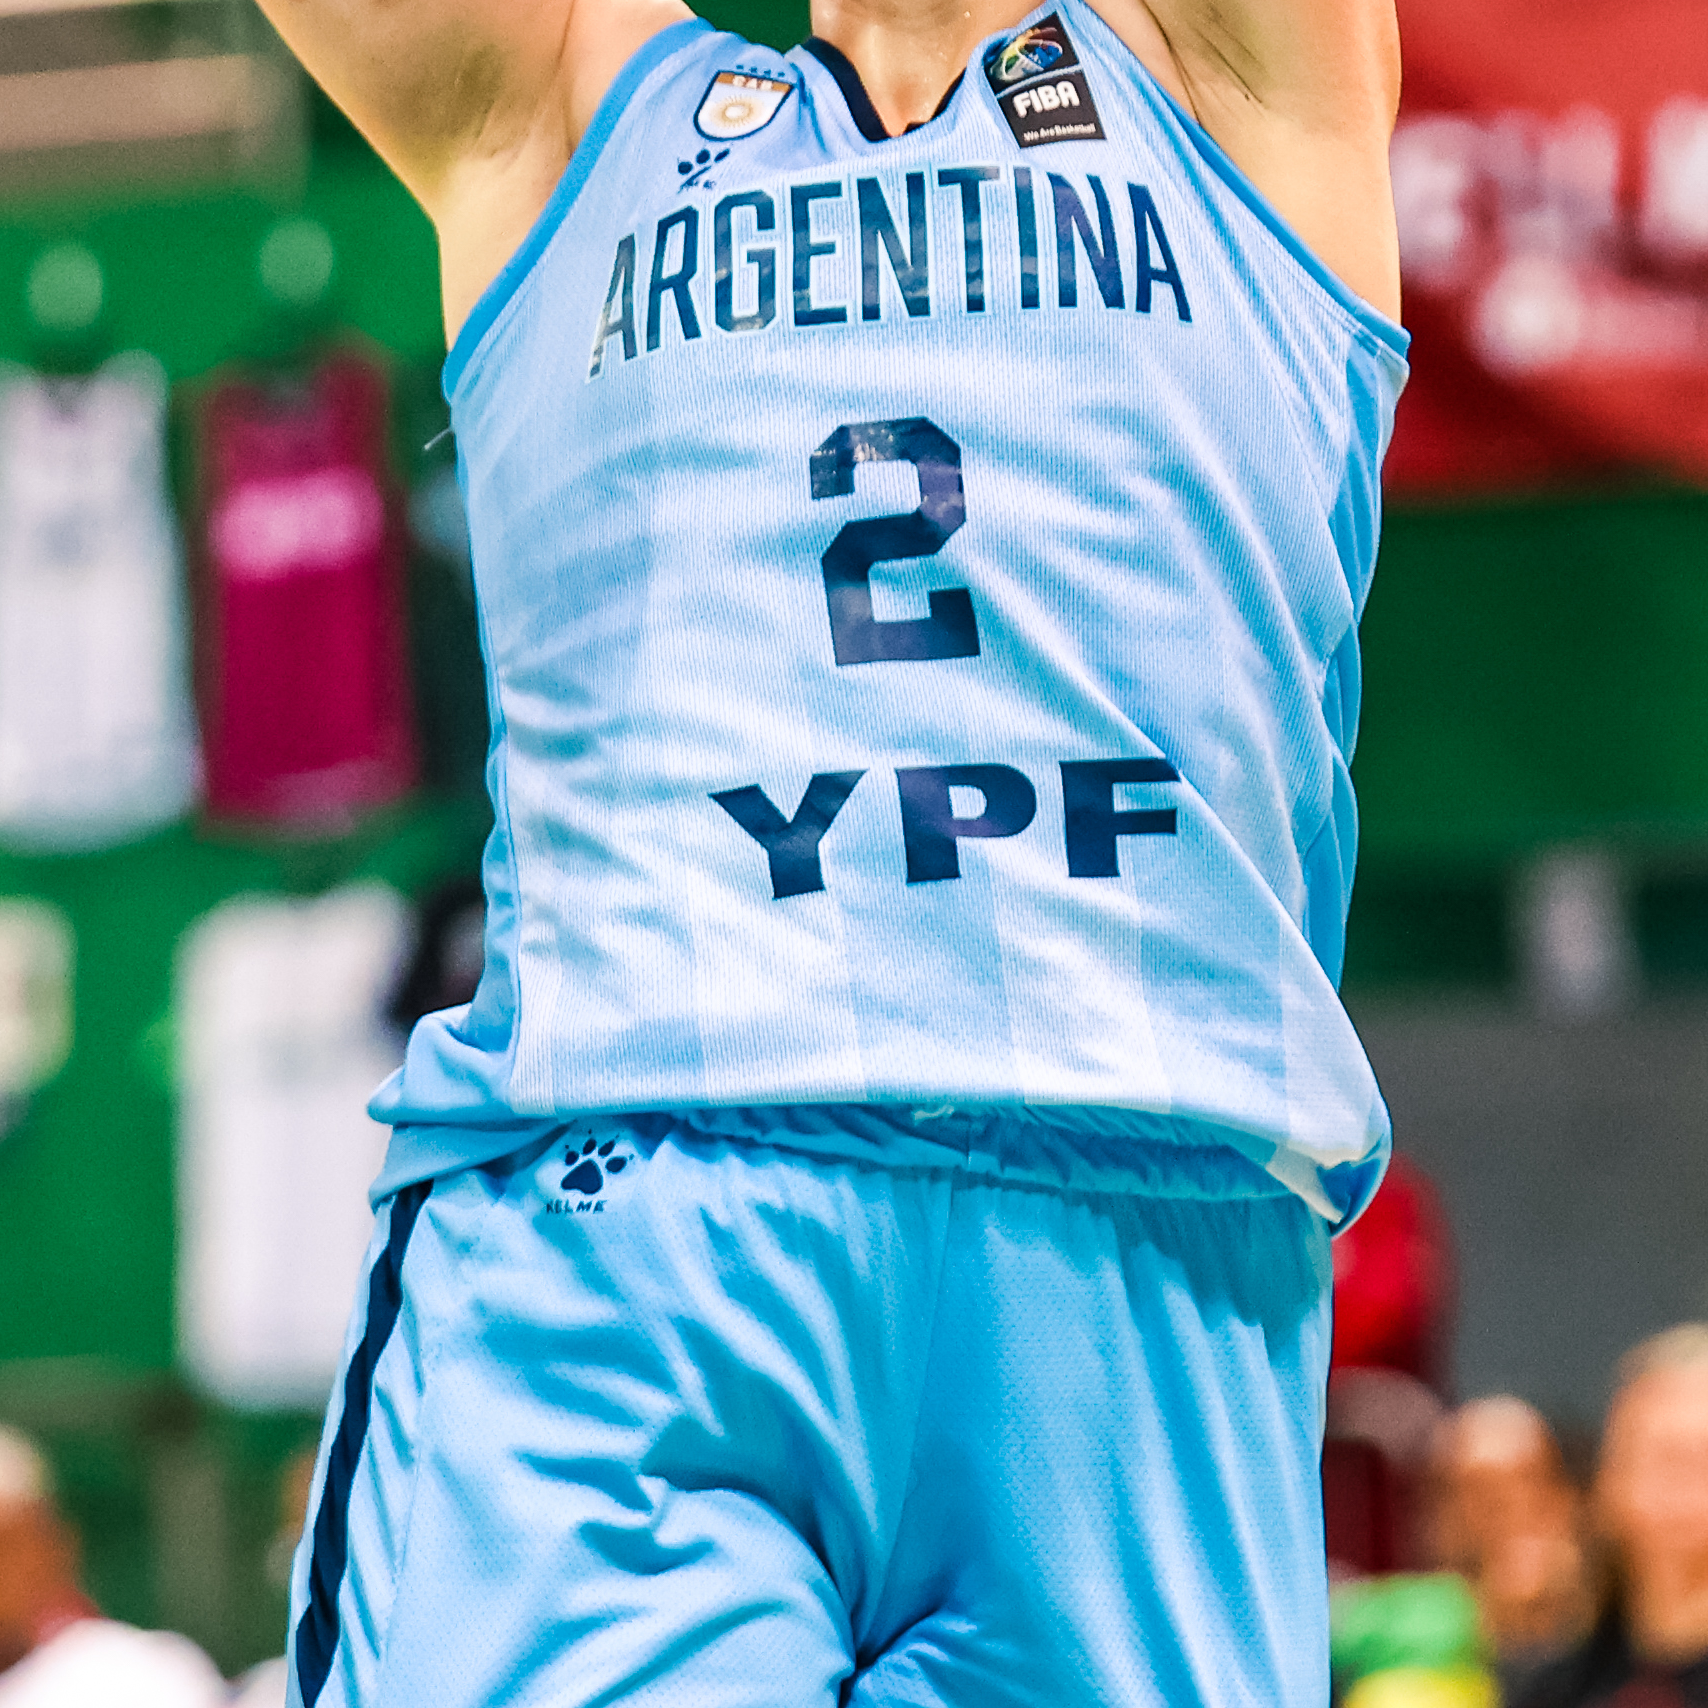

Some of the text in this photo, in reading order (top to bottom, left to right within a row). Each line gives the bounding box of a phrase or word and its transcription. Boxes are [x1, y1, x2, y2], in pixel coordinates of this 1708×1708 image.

[1013, 80, 1080, 118] FIBA
[589, 165, 1193, 380] ARGENTINA
[809, 417, 981, 666] 2
[709, 758, 1184, 901] YPF
